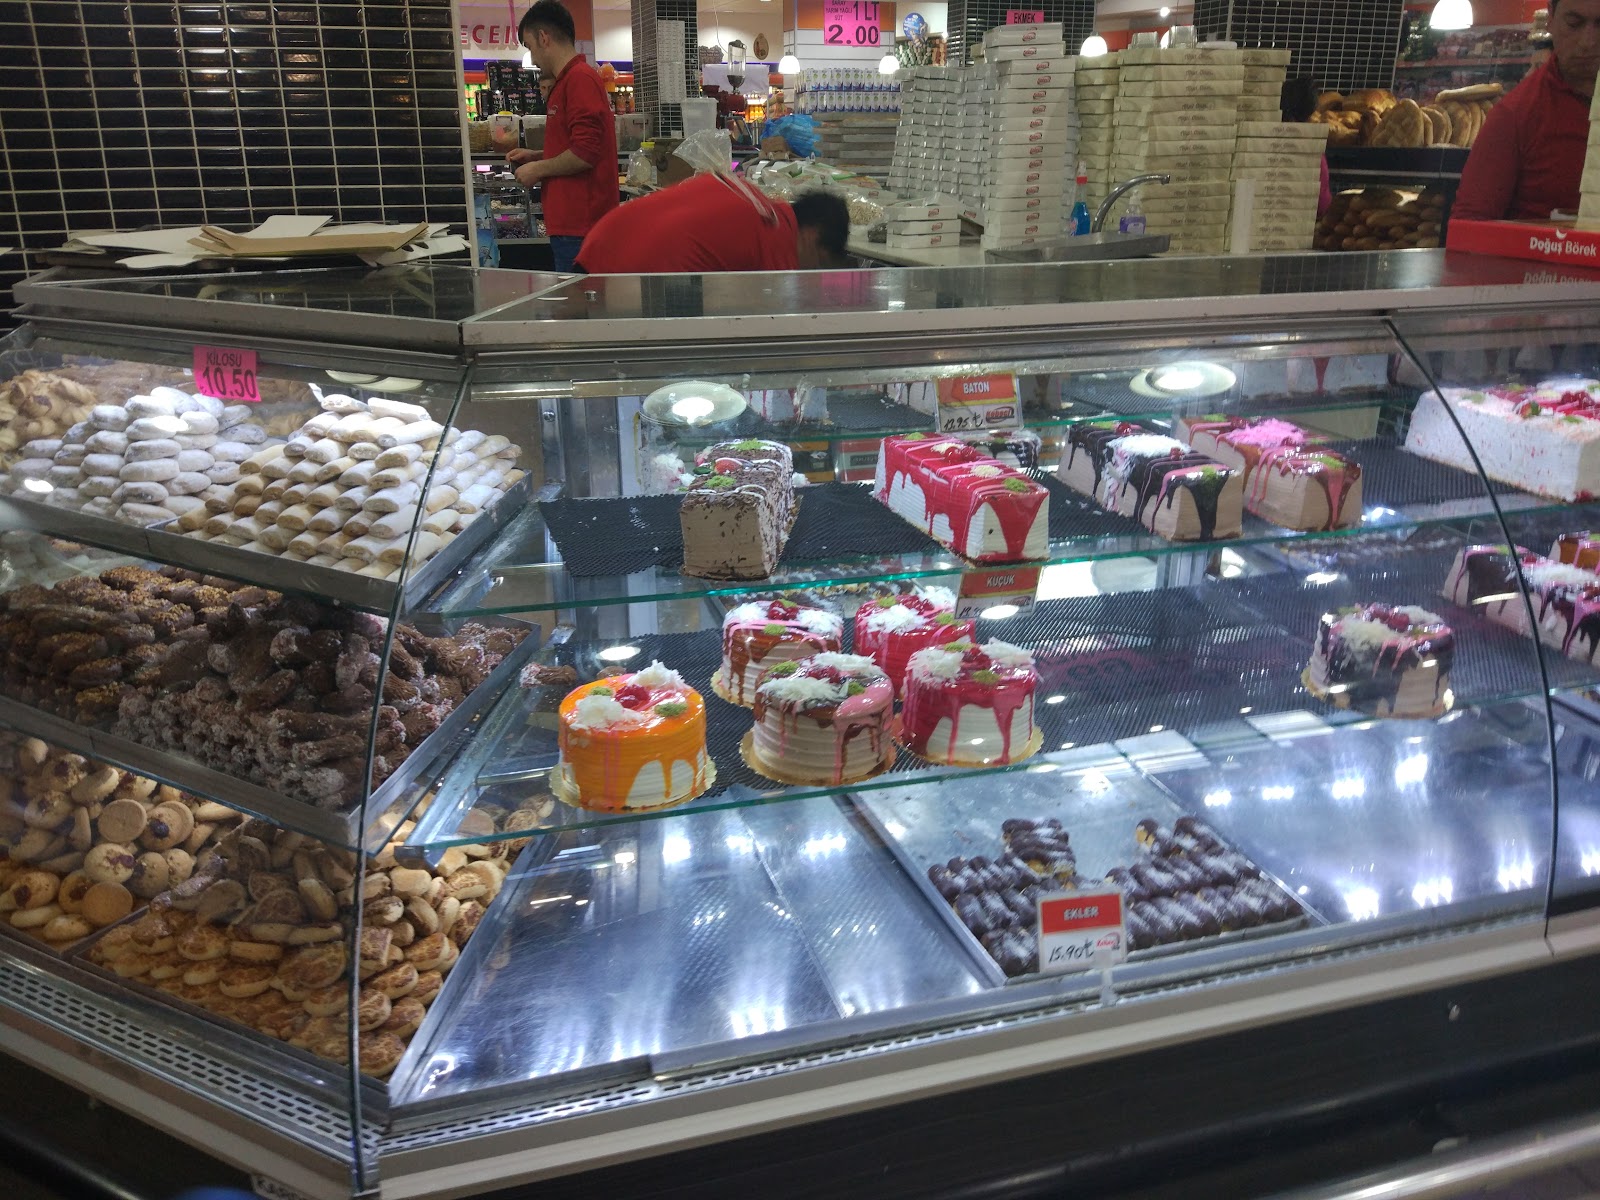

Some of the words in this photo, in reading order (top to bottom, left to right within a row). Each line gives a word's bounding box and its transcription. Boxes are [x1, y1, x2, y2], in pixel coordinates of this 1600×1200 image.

[1013, 12, 1036, 24] EKMEK
[828, 24, 879, 45] 2.00
[1530, 236, 1562, 255] Doğuş
[1565, 240, 1597, 257] Börek
[203, 367, 257, 398] 10.50
[963, 381, 990, 394] BATON
[1064, 906, 1099, 920] EKLER
